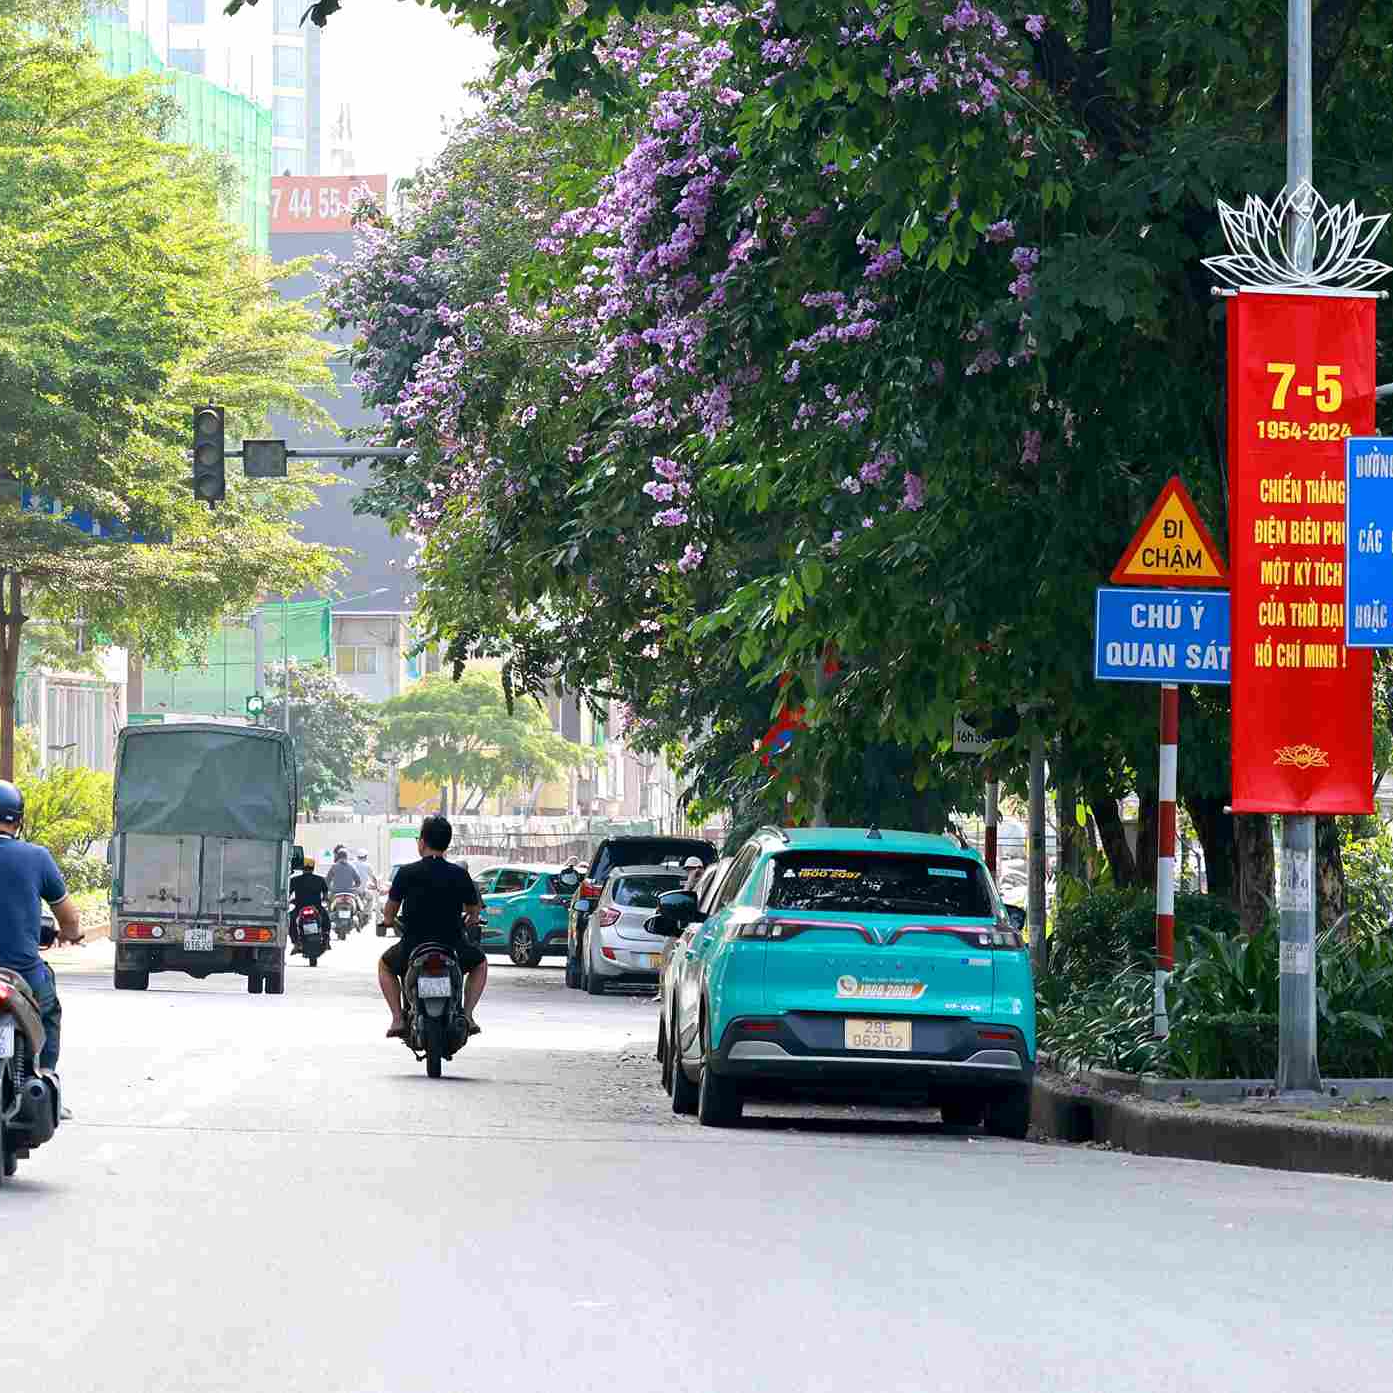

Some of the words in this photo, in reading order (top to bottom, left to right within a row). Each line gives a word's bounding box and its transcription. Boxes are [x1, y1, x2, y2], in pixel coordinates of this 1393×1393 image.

[1266, 362, 1343, 413] 7-5
[1256, 420, 1352, 441] 1954-2024
[1260, 471, 1302, 504] CHIẾN
[1305, 470, 1345, 504] THẮNG
[1163, 520, 1184, 539] ĐI
[1254, 514, 1287, 550] ĐIỆN
[1290, 515, 1321, 545] BIÊN
[1358, 521, 1383, 554] CÁC
[1142, 544, 1202, 573] CHẬM
[1260, 556, 1291, 590] MỘT
[1293, 556, 1312, 586] KỲ
[1313, 556, 1343, 587] TÍCH
[1131, 598, 1182, 630] CHÚ
[1190, 599, 1206, 631] Ý
[1259, 593, 1286, 627] CỦA
[1290, 596, 1319, 627] THỜI
[1321, 603, 1345, 633] ĐẠI
[1354, 599, 1388, 634] HOẶC
[1105, 641, 1176, 668] QUAN
[1185, 640, 1231, 670] SÁT
[1254, 634, 1273, 668] HỒ
[1276, 639, 1301, 669] CHÍ
[1304, 643, 1338, 669] MINH
